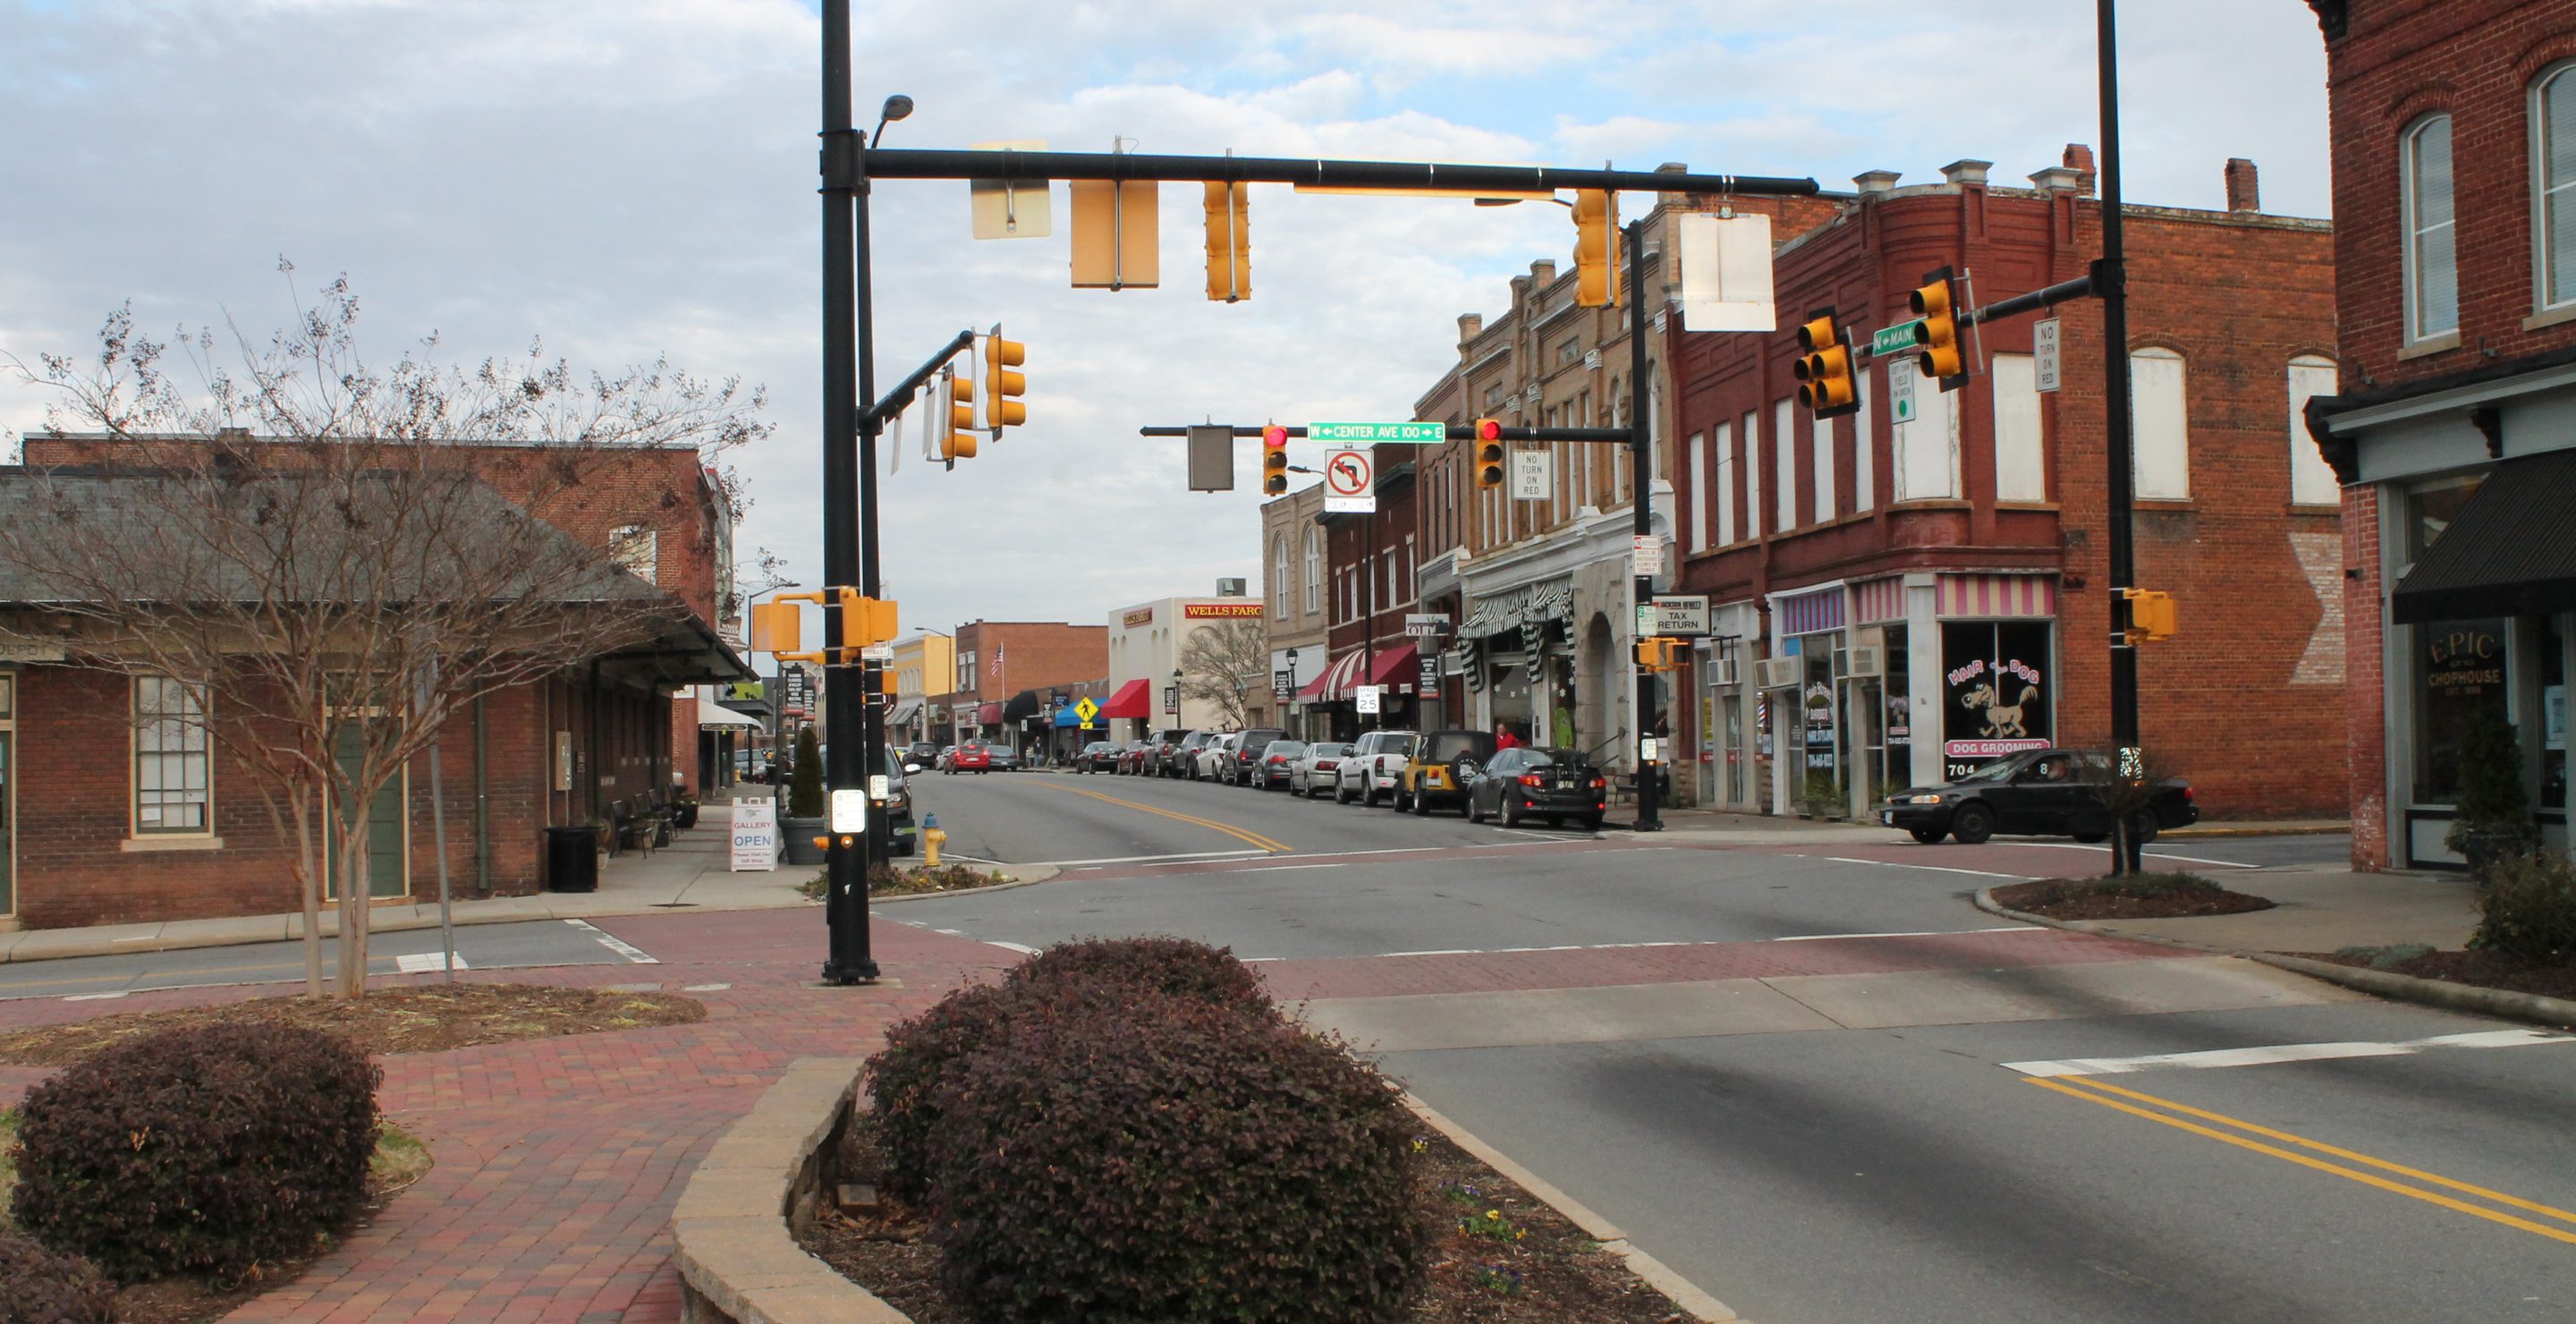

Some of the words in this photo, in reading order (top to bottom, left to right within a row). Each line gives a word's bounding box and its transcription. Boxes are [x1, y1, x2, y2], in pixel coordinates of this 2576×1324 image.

[1873, 335, 1882, 350] N
[1890, 327, 1912, 346] MAIN
[2041, 327, 2054, 340] NO
[2040, 344, 2055, 356] TURN
[2043, 359, 2053, 369] ON
[2042, 372, 2054, 384] RED
[1310, 426, 1320, 437] W
[1334, 426, 1374, 437] CENTER
[1377, 427, 1398, 437] AVE
[1402, 427, 1419, 438] 100
[1436, 428, 1443, 438] E
[1526, 455, 1538, 463] NO
[1521, 465, 1542, 474] TURN
[1526, 476, 1538, 484] ON
[1524, 486, 1539, 495] RED
[1188, 607, 1229, 615] WELLS
[1233, 607, 1262, 615] FARG
[1669, 612, 1687, 620] TAX
[1657, 621, 1699, 629] RETURN
[2431, 632, 2496, 664] EPIC
[1948, 659, 1984, 686] HAIR
[2009, 659, 2039, 684] DOG
[2428, 669, 2501, 687] CHOPHOUSE
[1360, 700, 1377, 709] 25
[1953, 743, 1978, 753] DOG
[1980, 743, 2042, 752] GROOMING
[1948, 764, 1975, 776] 704
[734, 836, 771, 846] OPEN
